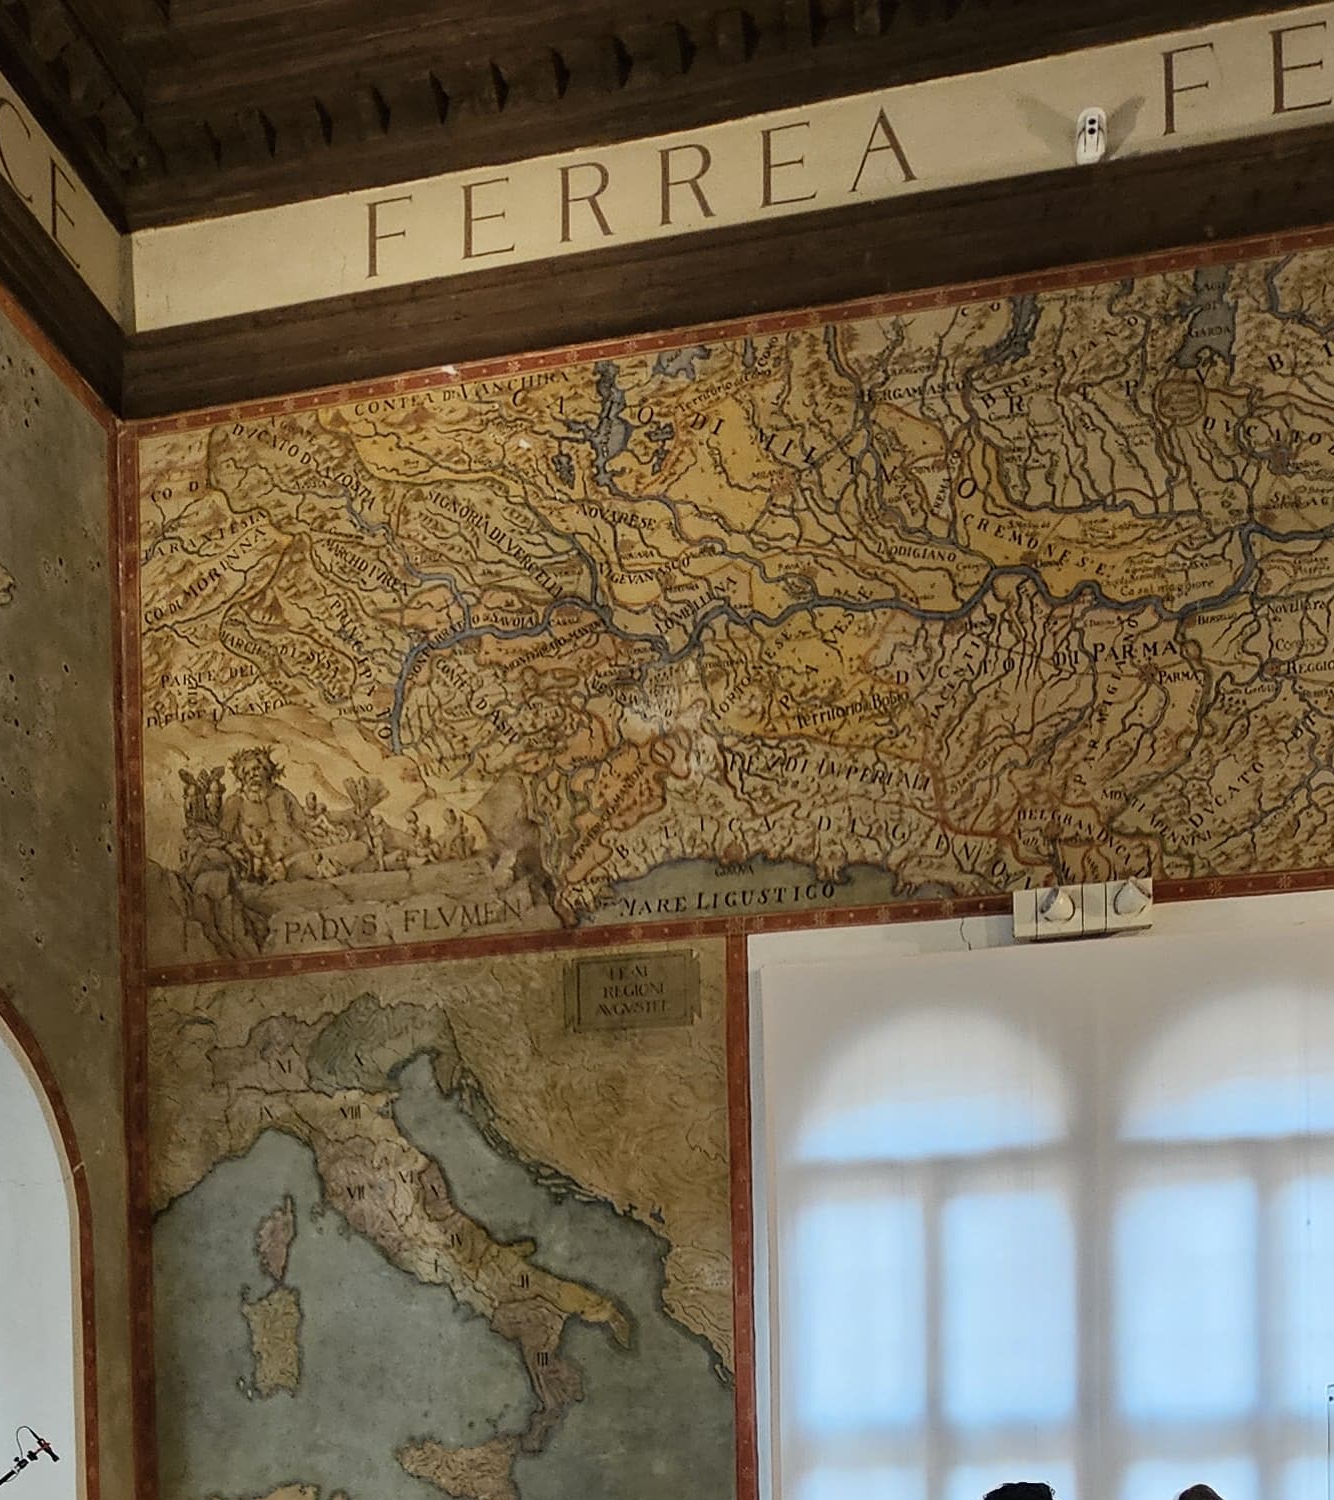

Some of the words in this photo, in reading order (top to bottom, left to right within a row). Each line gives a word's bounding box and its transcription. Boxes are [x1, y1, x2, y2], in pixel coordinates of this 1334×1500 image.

[366, 105, 918, 279] FERREA
[1092, 640, 1177, 663] PARMA
[284, 912, 379, 944] PADVS
